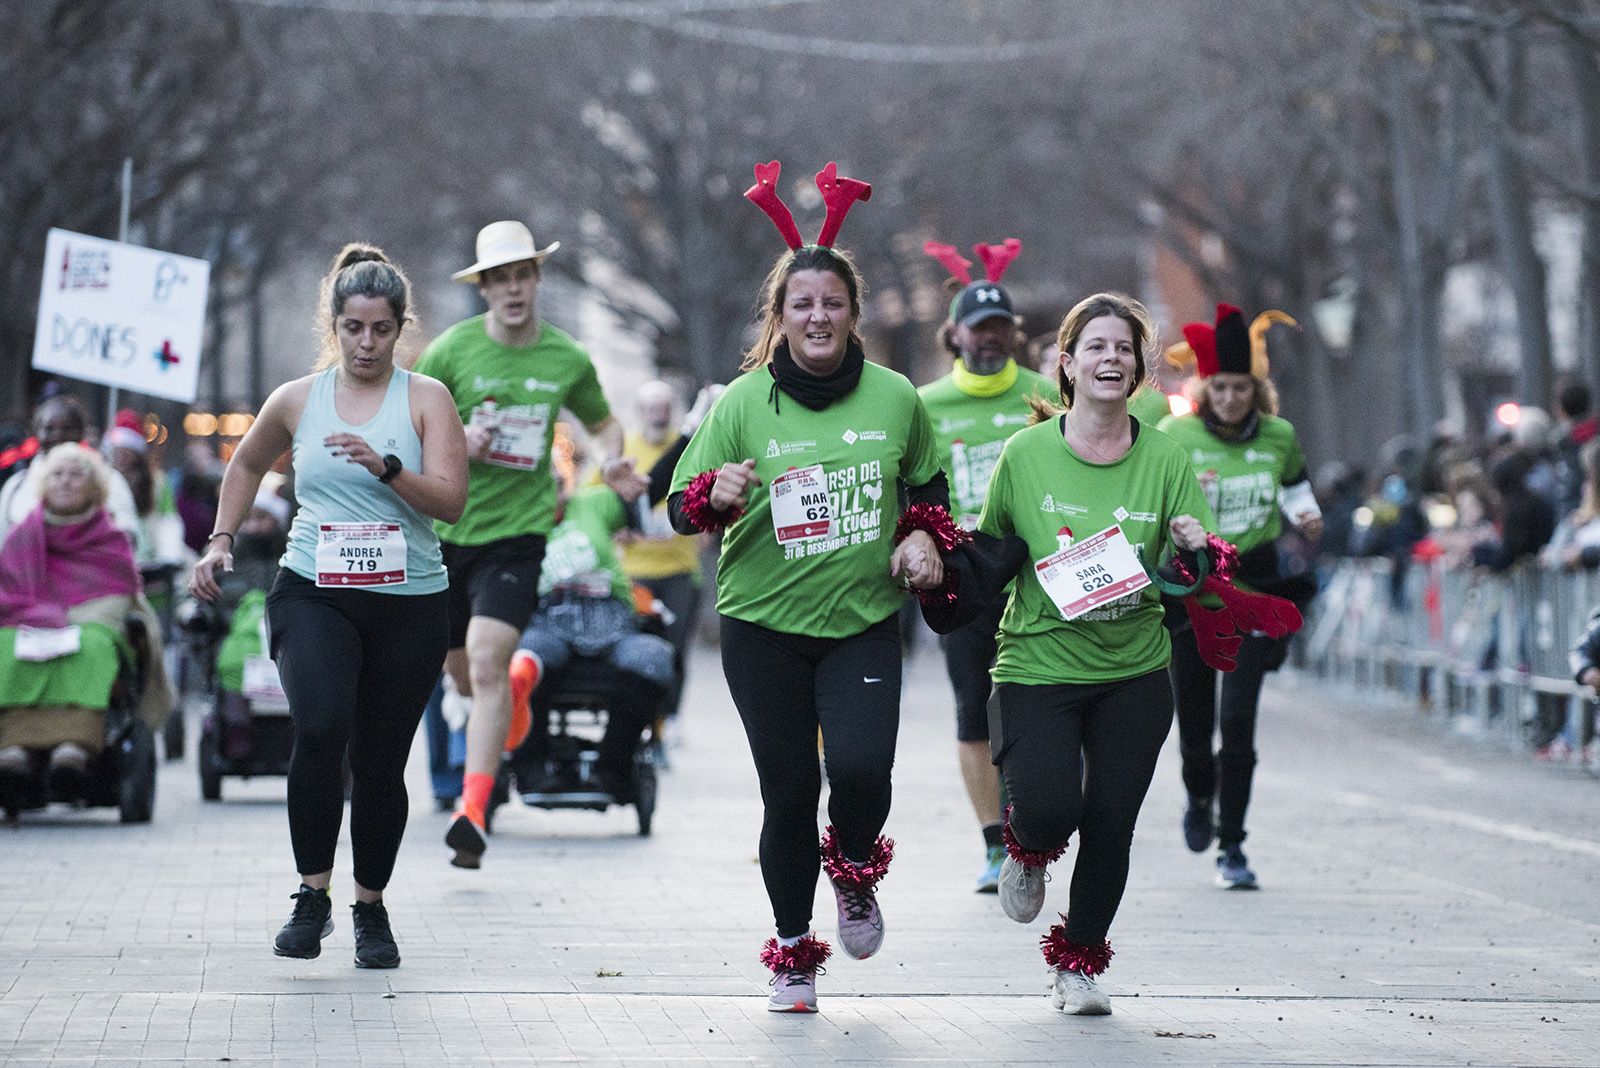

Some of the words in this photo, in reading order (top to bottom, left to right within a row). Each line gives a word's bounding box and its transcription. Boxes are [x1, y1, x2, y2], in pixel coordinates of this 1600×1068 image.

[51, 313, 139, 368] DONES
[860, 460, 882, 482] DEL
[843, 509, 882, 534] CUGAT
[339, 547, 383, 558] ANDREA
[784, 547, 794, 560] 31
[795, 545, 806, 558] DE
[807, 539, 849, 556] DESEMBRE
[851, 532, 862, 545] DE
[346, 559, 377, 572] 719
[1075, 563, 1106, 581] SARA
[1082, 573, 1114, 593] 620
